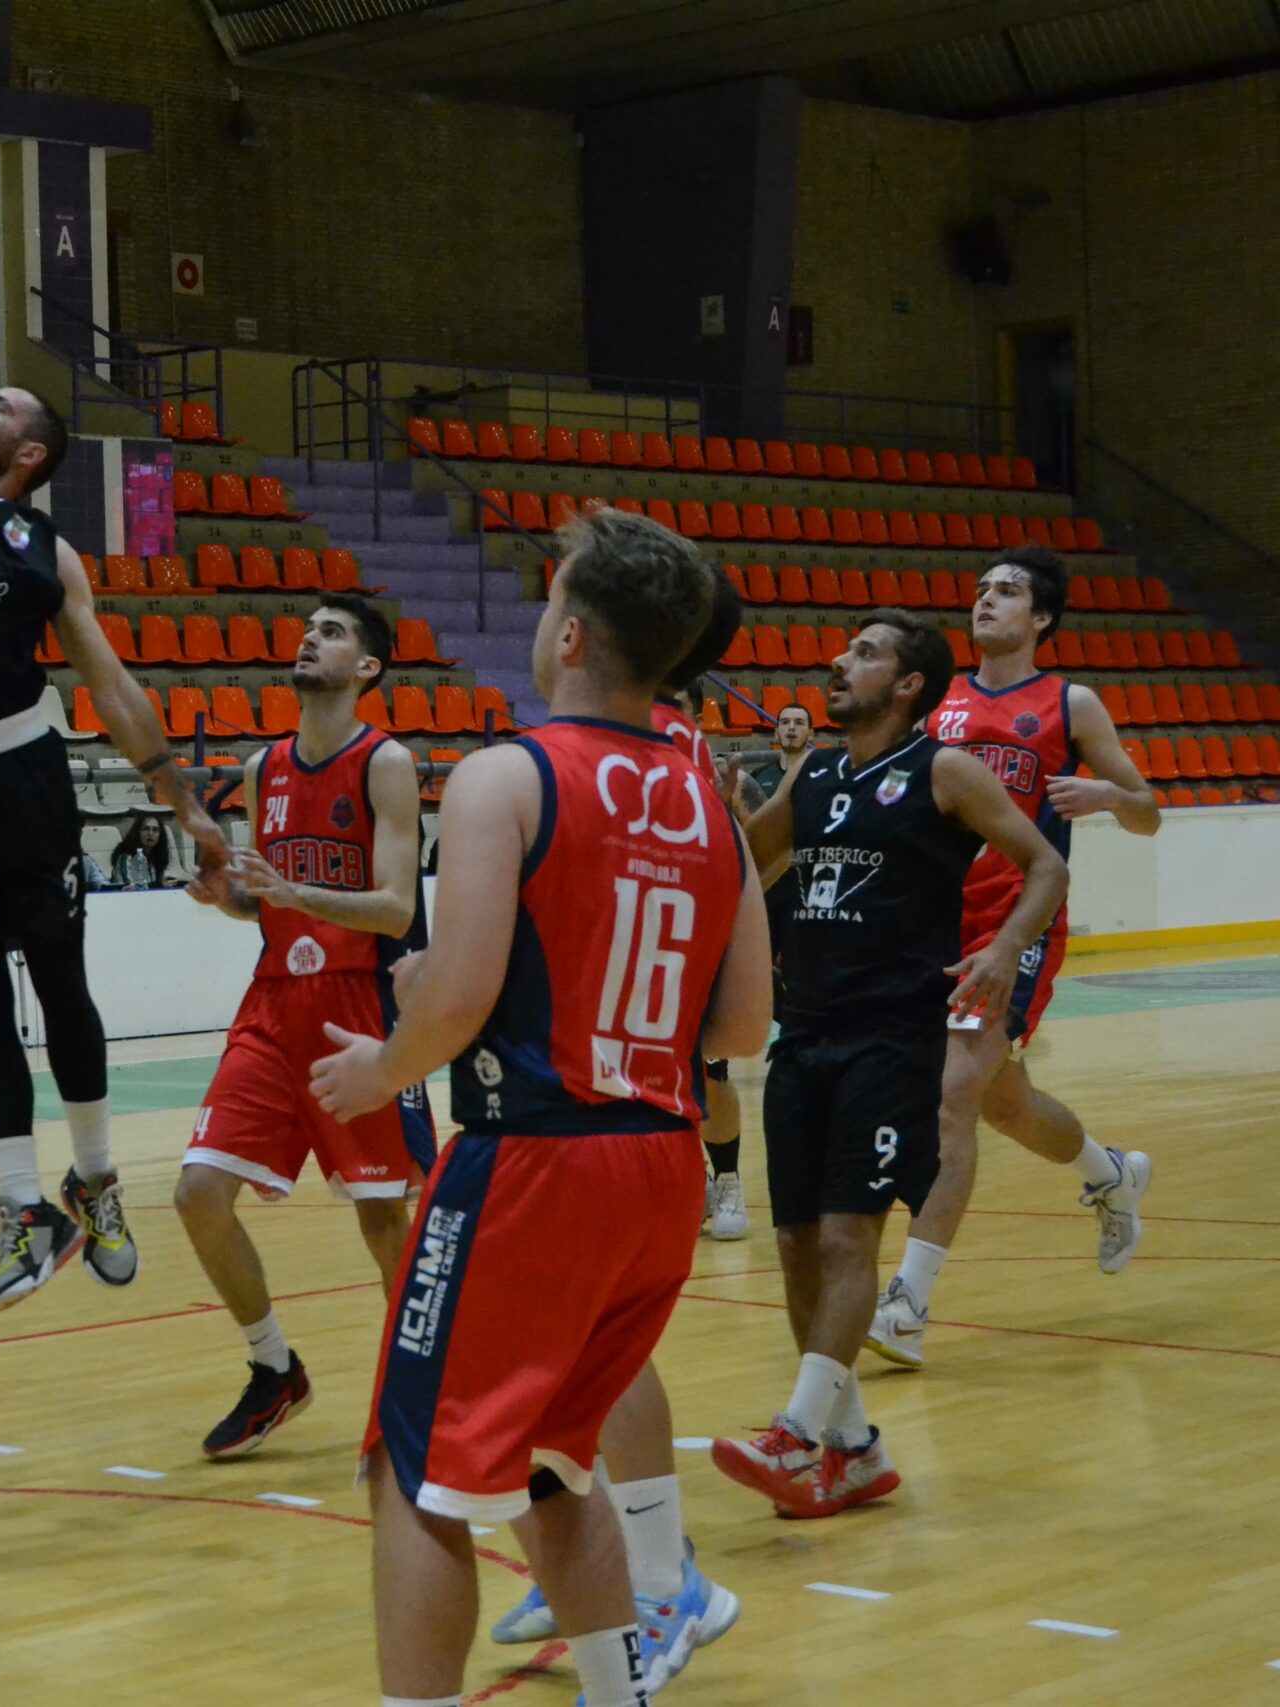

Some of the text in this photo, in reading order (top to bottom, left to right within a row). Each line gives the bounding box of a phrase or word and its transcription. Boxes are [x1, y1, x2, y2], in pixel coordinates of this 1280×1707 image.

[56, 225, 75, 258] A
[768, 305, 781, 332] A
[937, 710, 970, 742] 22
[263, 795, 290, 835] 24
[823, 792, 852, 834] 9
[268, 838, 366, 890] AENCB
[818, 845, 884, 867] IBÉRICO
[596, 875, 696, 1041] 16
[874, 1125, 898, 1169] 9
[359, 1165, 389, 1176] vive
[421, 1279, 449, 1357] CLIMBING
[440, 1210, 467, 1276] CENTER
